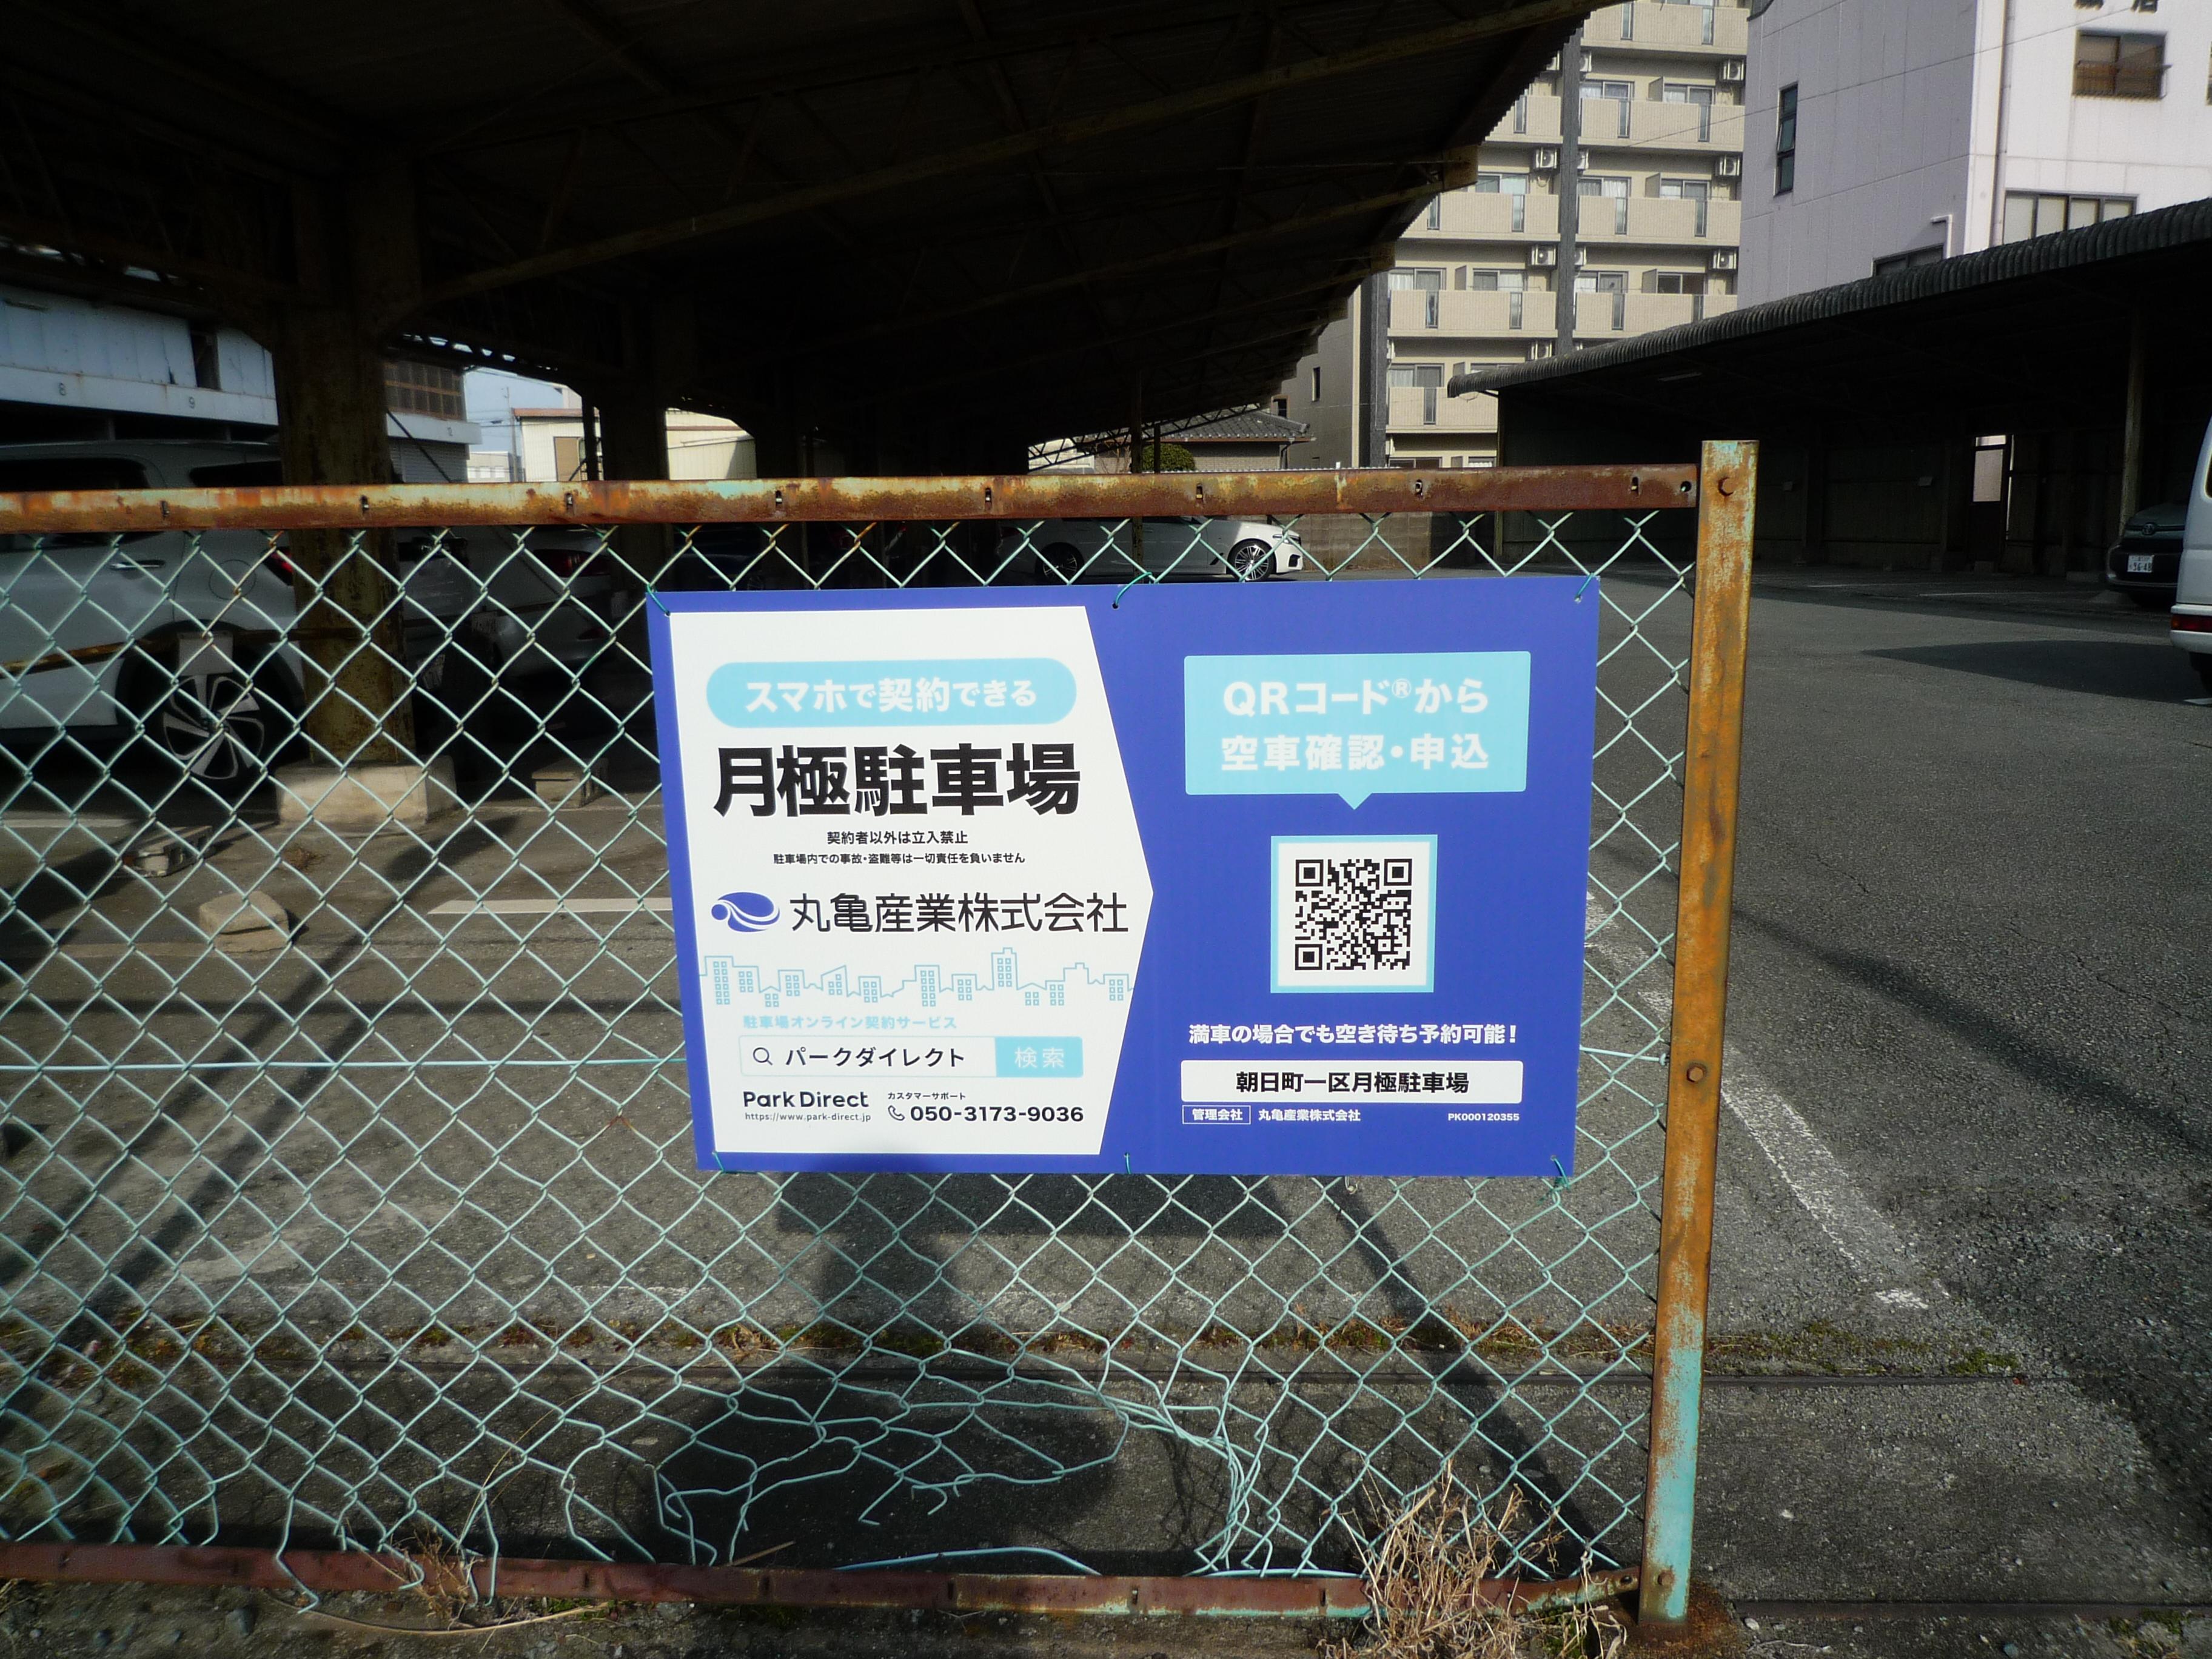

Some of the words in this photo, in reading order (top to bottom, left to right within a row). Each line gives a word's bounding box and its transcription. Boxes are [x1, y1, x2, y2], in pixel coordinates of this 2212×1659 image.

[189, 397, 196, 409] 9
[746, 676, 1037, 713] スマホで契約できる
[1221, 733, 1489, 771] 空車確認・申込
[713, 742, 1081, 817] 月極駐車場
[827, 830, 968, 845] 契約者以外は立入禁止
[789, 891, 1128, 933] 丸亀産業株式会社
[743, 1015, 956, 1030] 駐車場オンライン契約サービス
[785, 1047, 964, 1067] パークダイレクト
[1014, 1047, 1064, 1068] 検索
[1236, 1071, 1469, 1093] 朝日町一区月極駐車場
[743, 1091, 796, 1107] Park
[800, 1091, 869, 1108] Direct
[888, 1092, 966, 1101] カスタマーサポート
[745, 1112, 871, 1122] https://www.park-direct.jp
[910, 1105, 1084, 1122] 050-3173-9036
[1192, 1108, 1243, 1121] 管理会社
[1258, 1108, 1361, 1122] 丸亀産業株式会社
[1448, 1113, 1520, 1121] PK000120355
